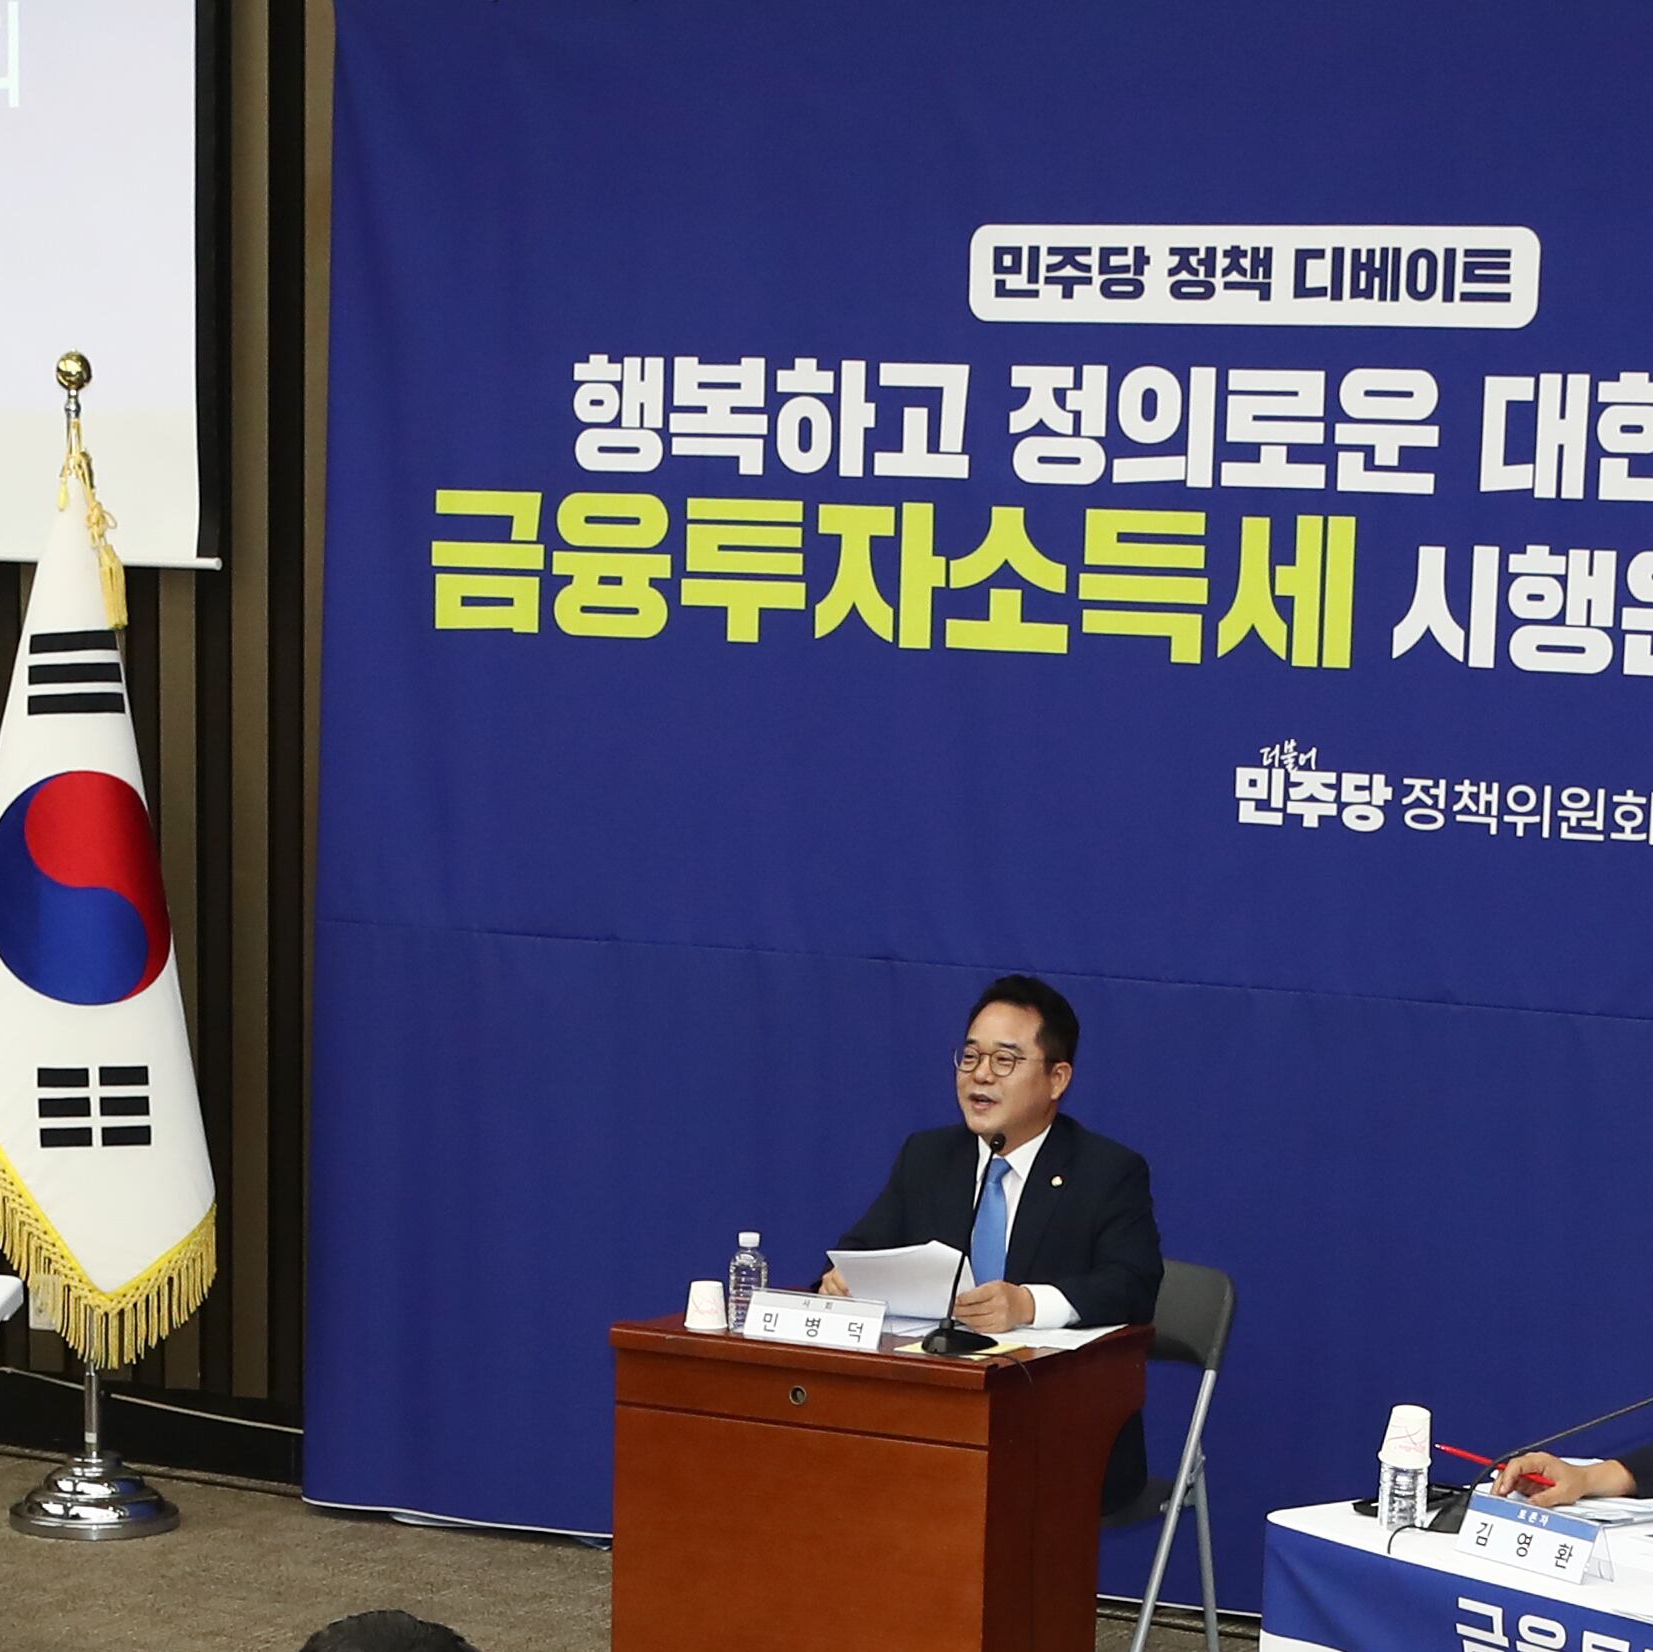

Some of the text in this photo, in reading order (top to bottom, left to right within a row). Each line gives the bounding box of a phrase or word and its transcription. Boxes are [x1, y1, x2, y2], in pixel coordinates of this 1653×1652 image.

[992, 244, 1512, 303] 민주당 정책 디베이트
[572, 354, 970, 479] 행복하고
[1008, 364, 1440, 493] 정의로운
[430, 488, 1358, 669] 금융투자소득세
[1259, 738, 1318, 772] 더불어
[1234, 766, 1393, 832] 민주당
